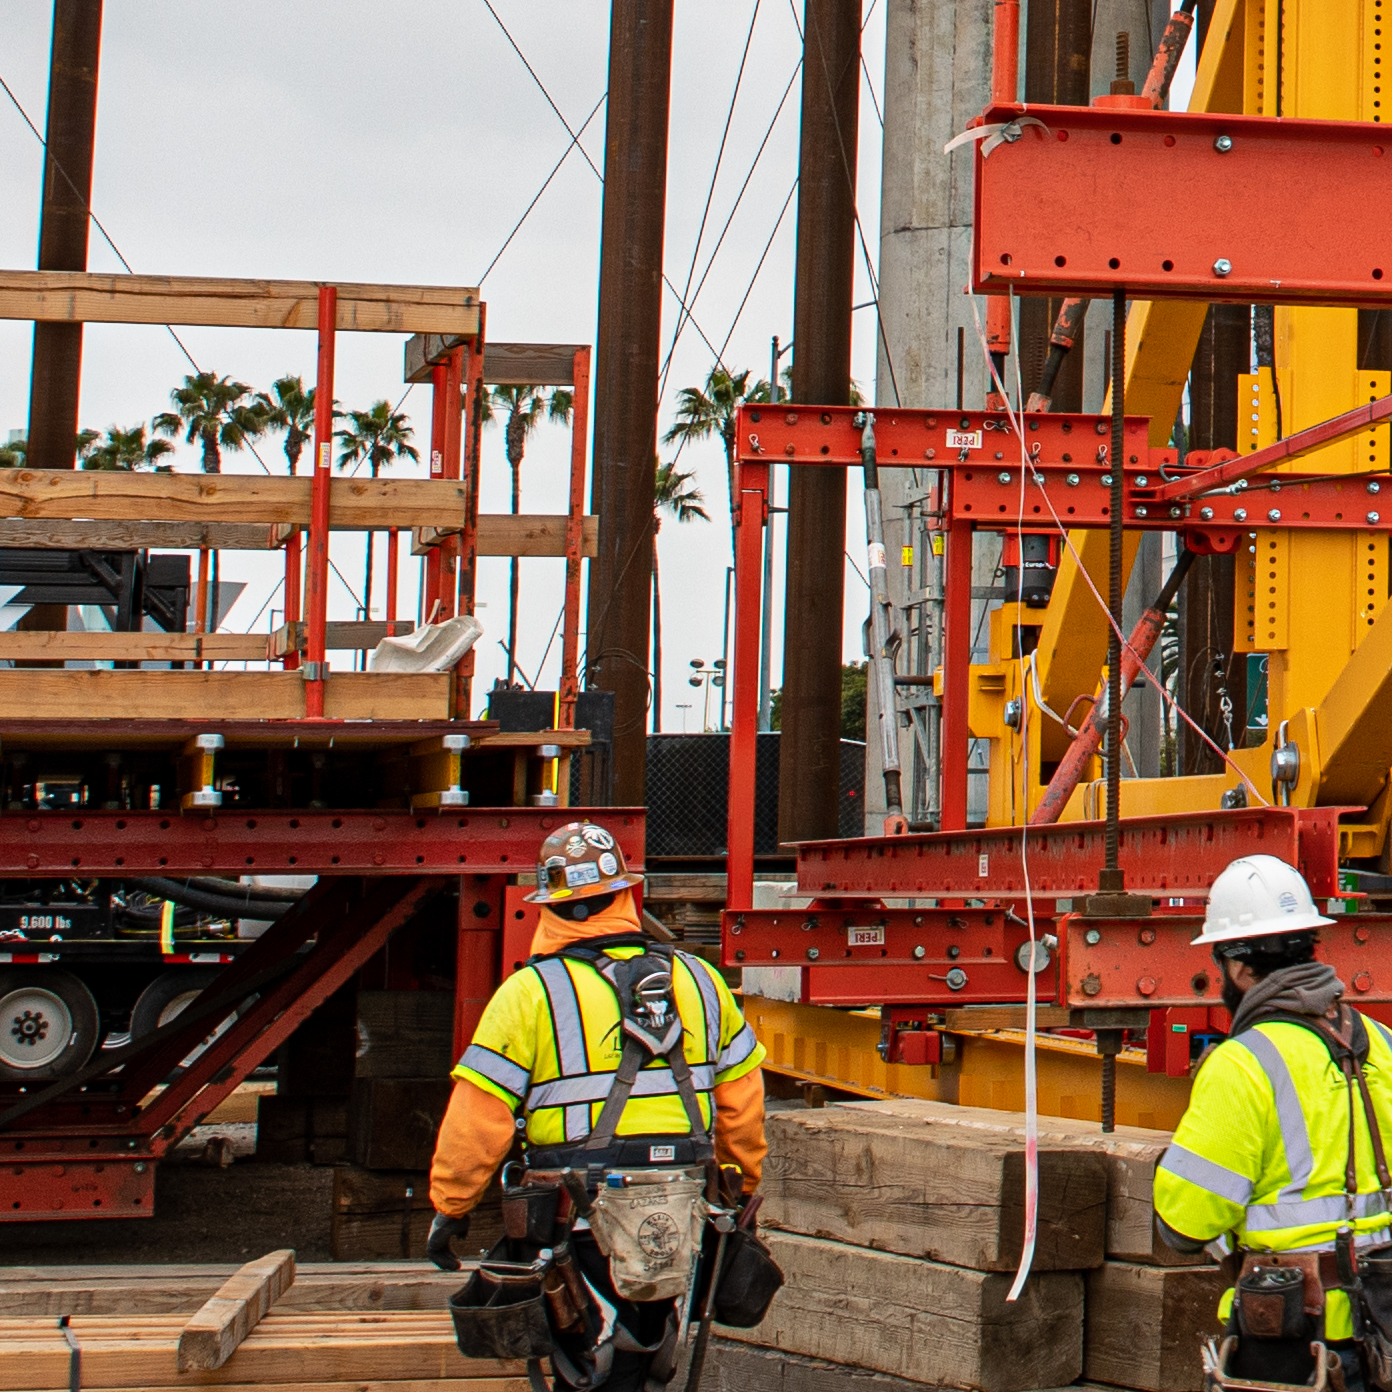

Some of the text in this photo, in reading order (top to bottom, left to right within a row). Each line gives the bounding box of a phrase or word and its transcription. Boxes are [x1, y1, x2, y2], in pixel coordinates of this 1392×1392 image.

[953, 436, 975, 445] PERI
[20, 915, 72, 929] 9,600 lbs
[855, 932, 878, 943] PERI
